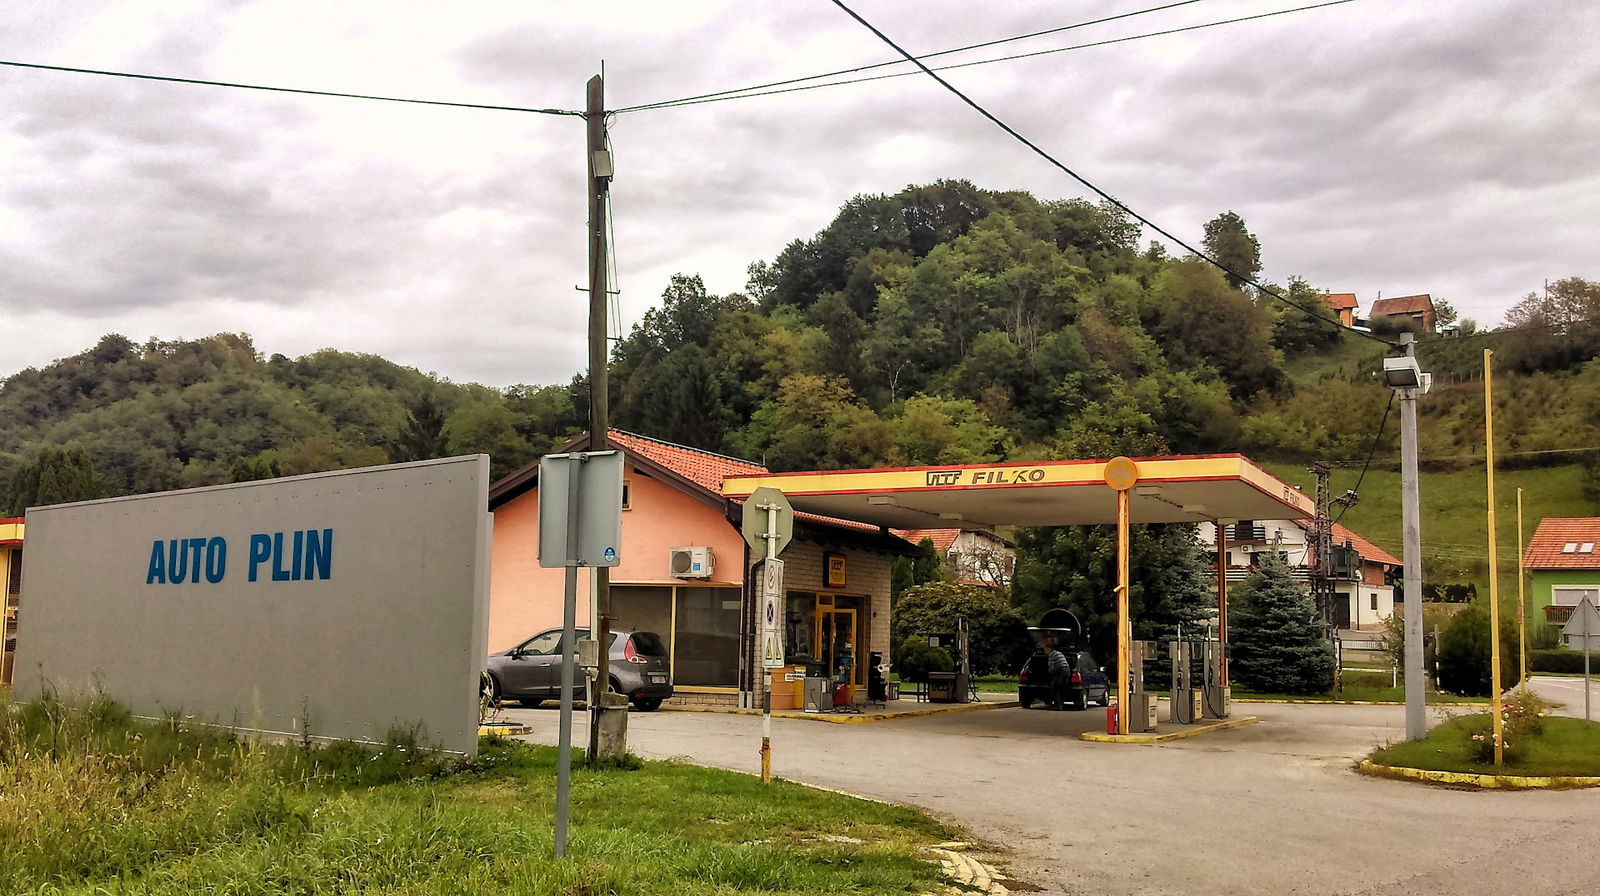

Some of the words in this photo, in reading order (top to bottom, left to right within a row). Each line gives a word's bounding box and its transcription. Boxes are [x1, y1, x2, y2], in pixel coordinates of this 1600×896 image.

[972, 469, 1046, 485] FILKO
[146, 536, 227, 585] AUTO
[248, 528, 333, 582] PLIN
